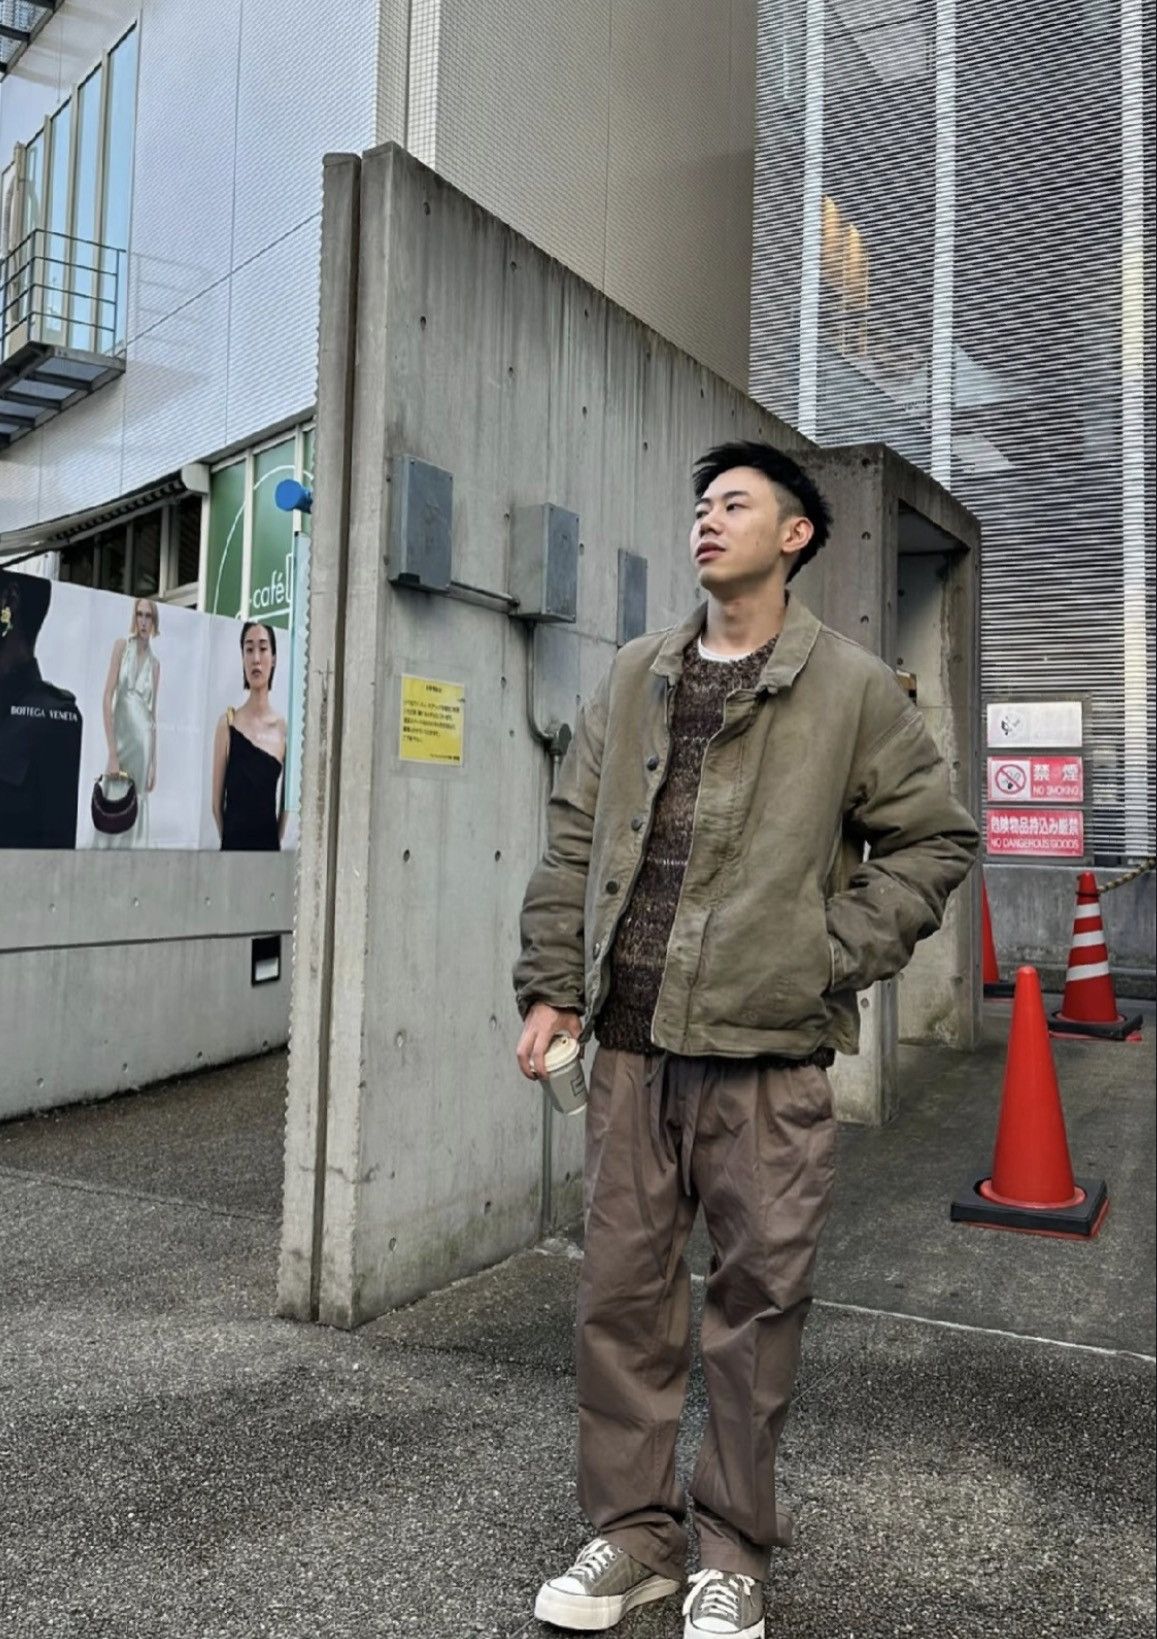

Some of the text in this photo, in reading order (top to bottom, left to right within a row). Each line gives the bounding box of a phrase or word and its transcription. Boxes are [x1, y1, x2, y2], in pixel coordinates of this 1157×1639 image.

[253, 570, 285, 609] café
[10, 705, 78, 722] BOTTEGA VENETA
[1033, 785, 1079, 796] NO SMOKING
[991, 838, 1079, 850] NO DANGEROUS GOODS
